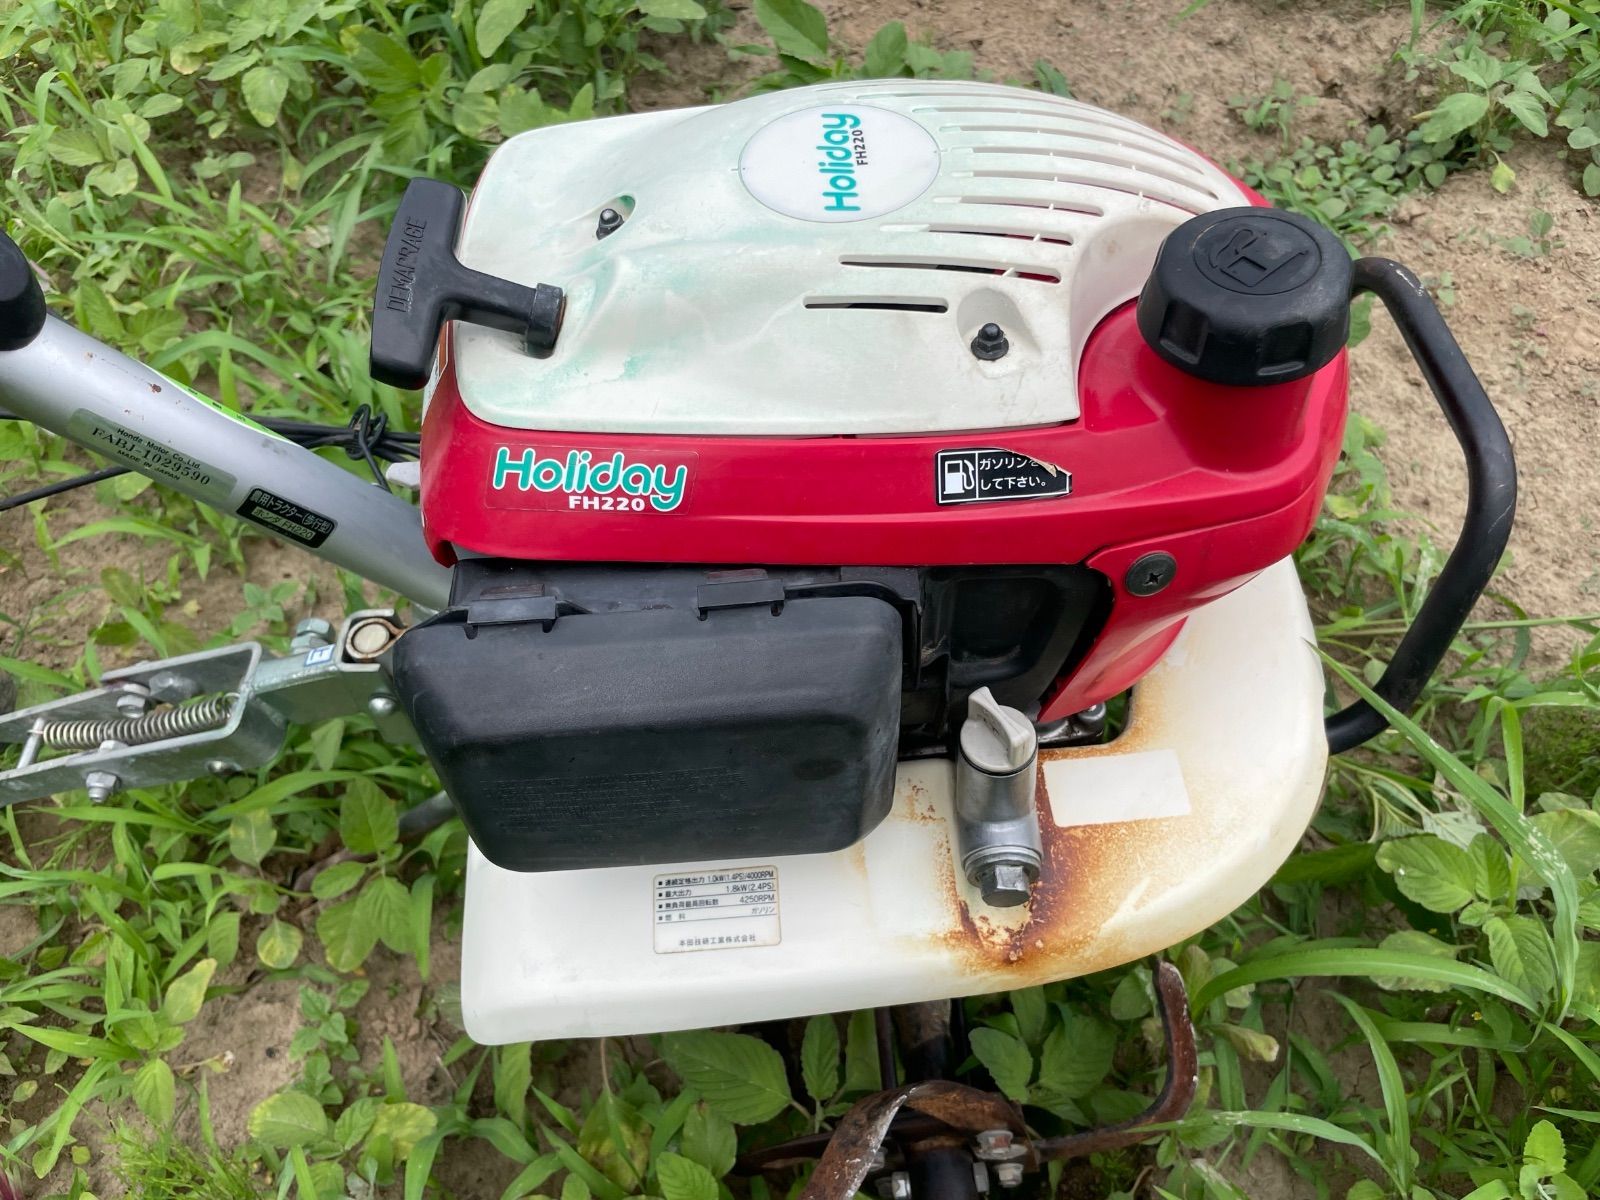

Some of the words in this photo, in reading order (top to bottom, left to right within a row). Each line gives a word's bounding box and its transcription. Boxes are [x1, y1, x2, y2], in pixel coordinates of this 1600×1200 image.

[815, 112, 862, 212] Holiday
[851, 129, 868, 166] FH220
[92, 427, 210, 485] FABJ-1029590
[116, 428, 144, 444] Honda
[146, 441, 170, 456] Motor
[117, 449, 141, 463] MADE
[154, 467, 180, 480] JAPAN
[492, 446, 688, 512] Holiday
[980, 476, 1047, 491] して下さい。
[568, 495, 646, 512] FH220
[281, 521, 313, 539] FH220
[739, 893, 775, 904] 4250RPM
